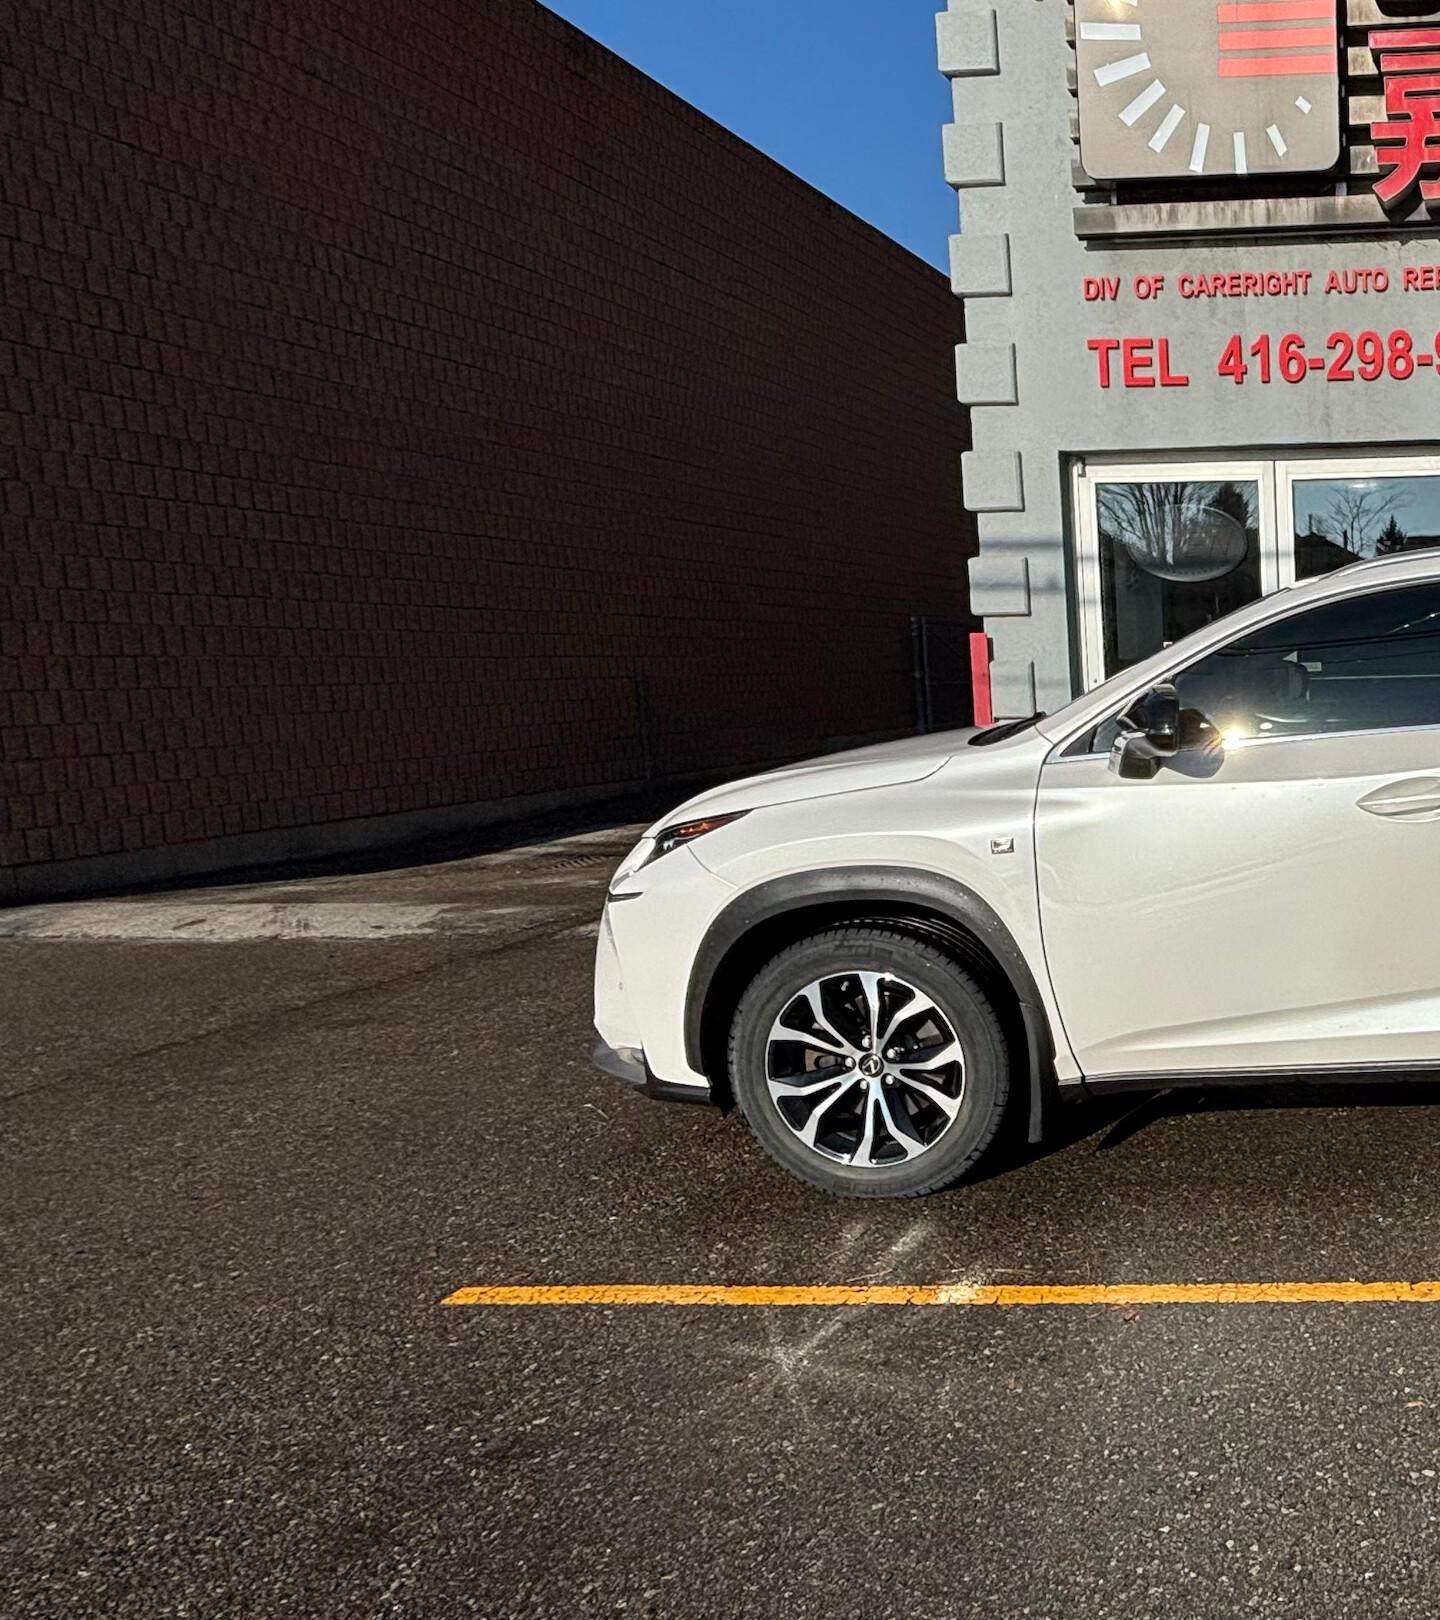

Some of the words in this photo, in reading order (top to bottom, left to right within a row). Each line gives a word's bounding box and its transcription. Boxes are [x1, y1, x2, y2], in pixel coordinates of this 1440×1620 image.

[1083, 275, 1120, 300] DIV
[1132, 274, 1164, 298] OF
[1177, 271, 1312, 298] CARERIGHT
[1324, 268, 1389, 294] AUTO
[1087, 337, 1189, 388] TEL
